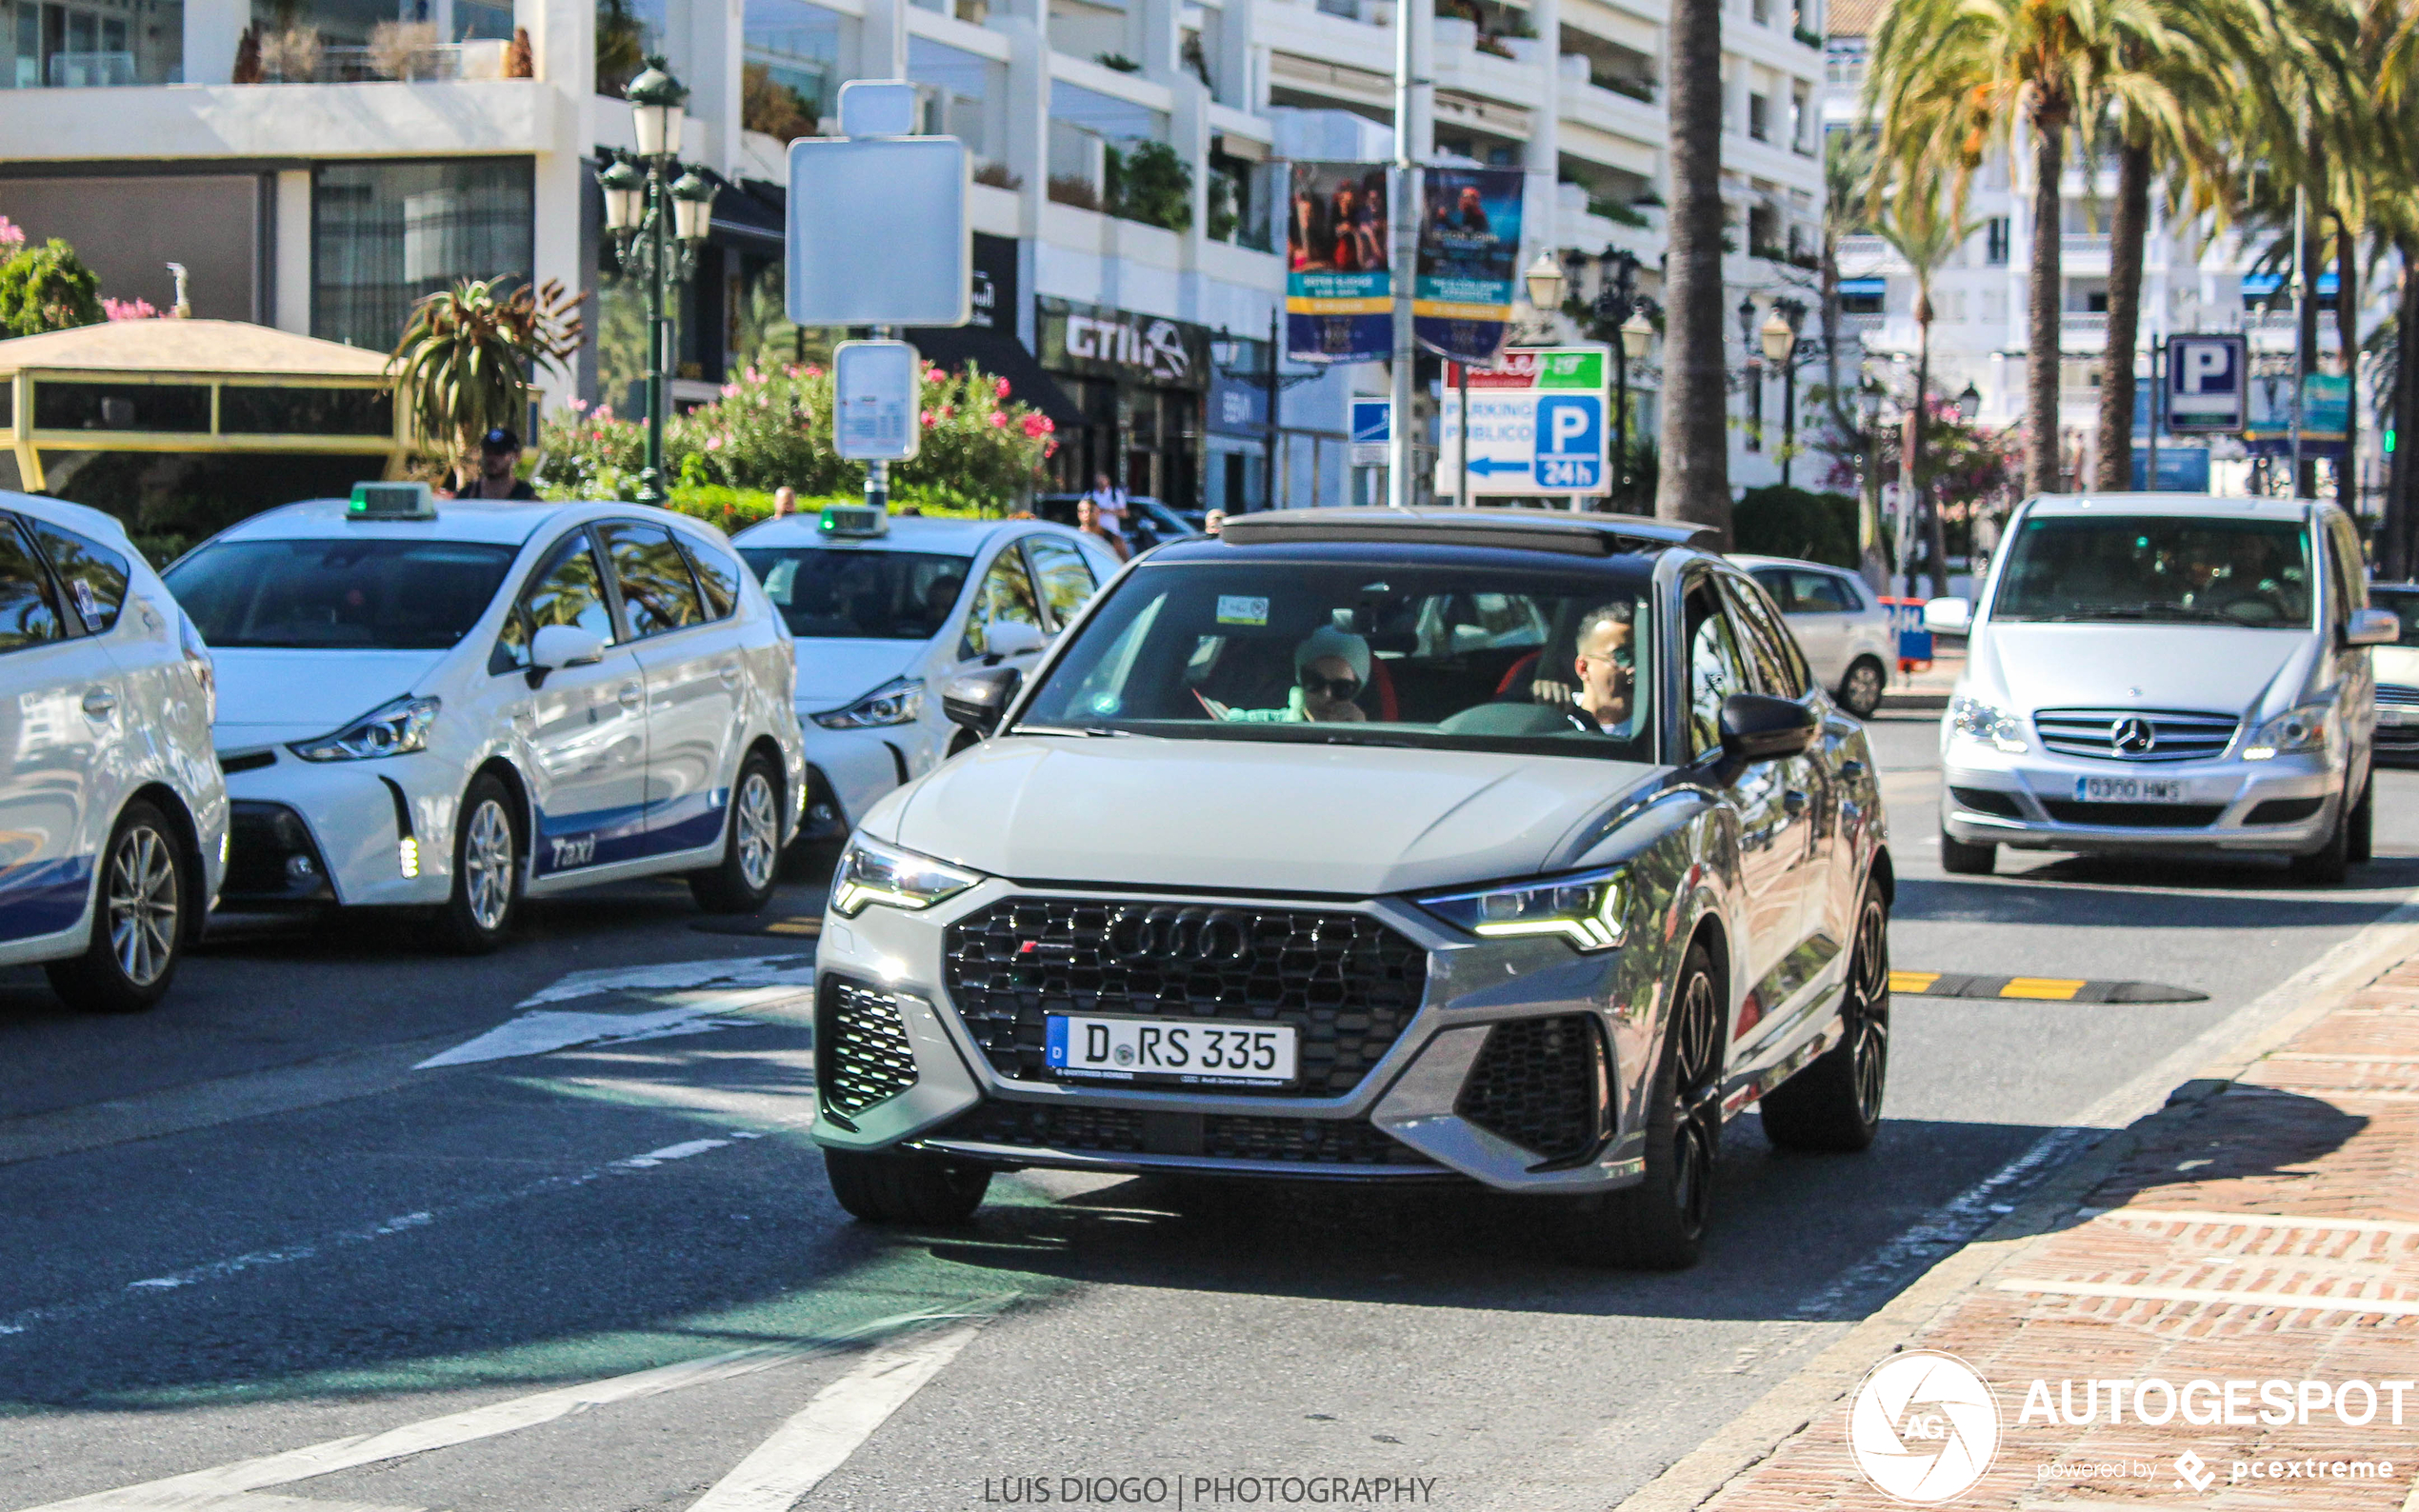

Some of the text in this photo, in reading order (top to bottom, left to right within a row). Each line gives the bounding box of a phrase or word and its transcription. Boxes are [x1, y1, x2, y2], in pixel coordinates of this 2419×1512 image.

[2184, 343, 2229, 393] P
[1446, 402, 1533, 418] PRKING
[1551, 406, 1589, 453] P
[1544, 463, 1593, 487] 24h
[550, 832, 596, 868] Taxi
[1051, 1046, 1063, 1060] D
[1086, 1024, 1276, 1071] D RS 335
